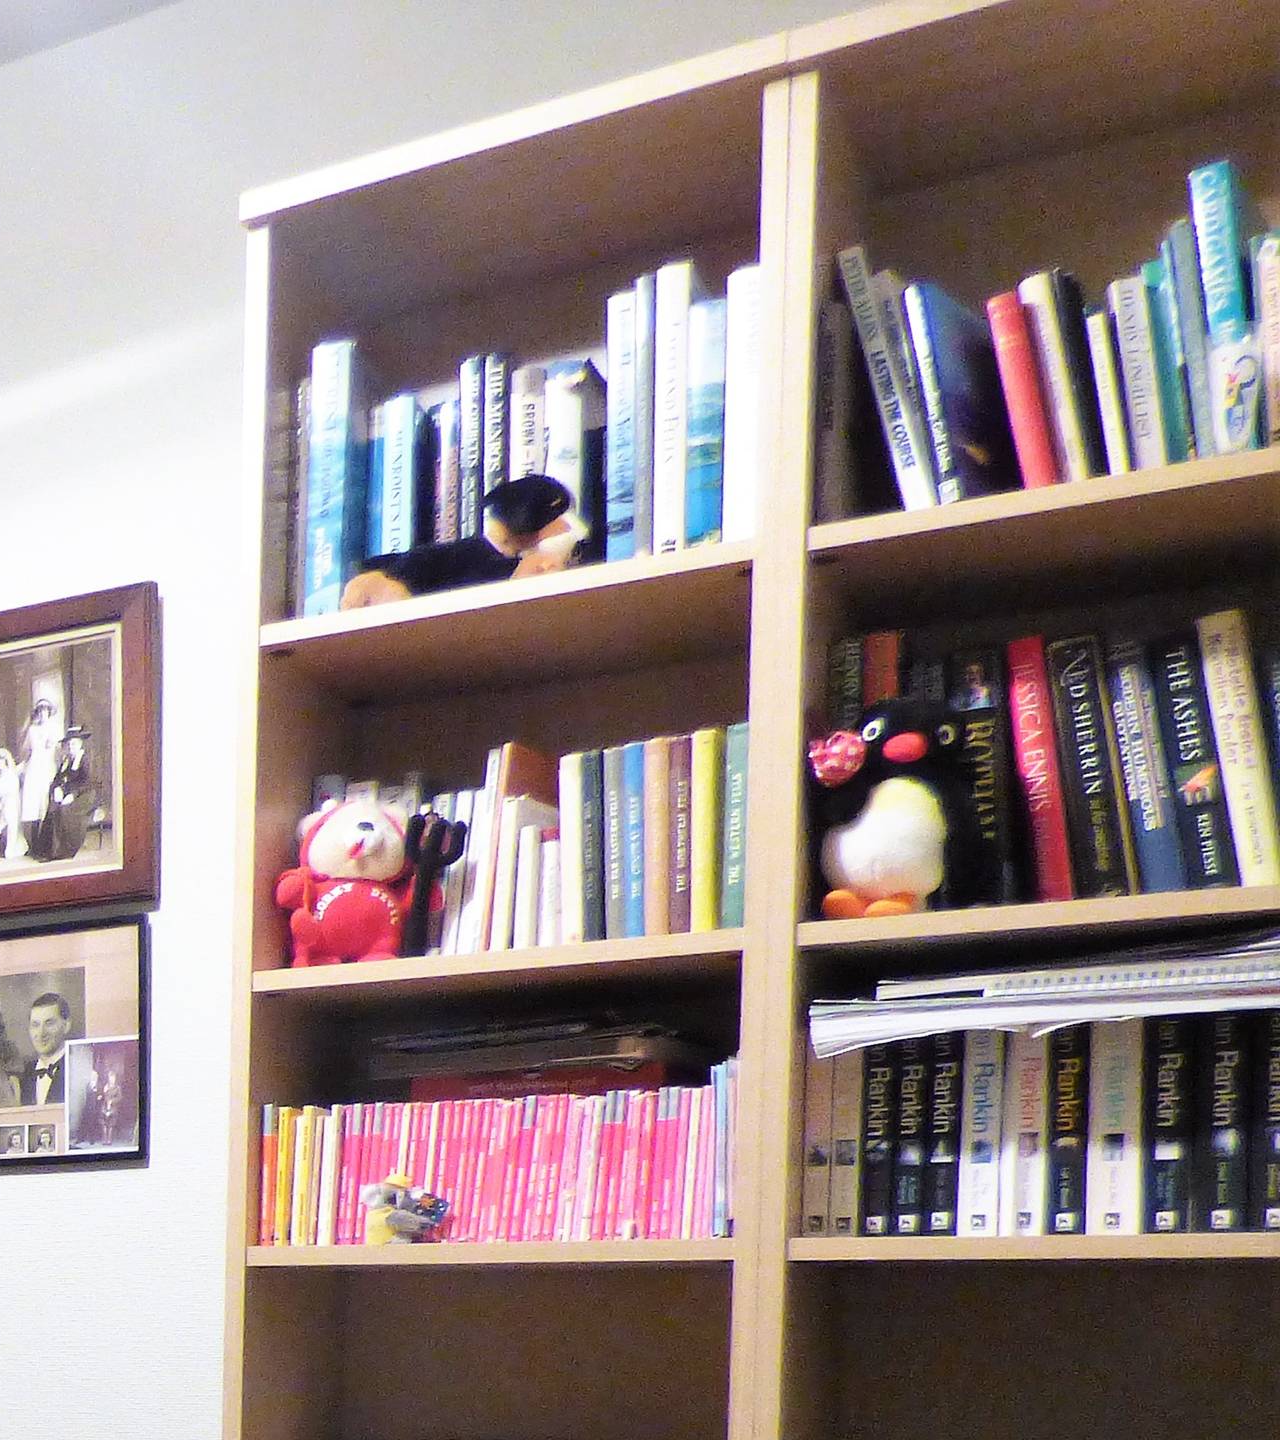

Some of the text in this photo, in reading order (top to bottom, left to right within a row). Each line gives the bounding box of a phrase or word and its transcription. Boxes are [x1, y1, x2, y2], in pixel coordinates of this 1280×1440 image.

[871, 349, 897, 401] LASTING
[1120, 284, 1139, 342] HENRY
[1134, 348, 1152, 438] LONGHURST
[489, 367, 505, 472] THE MUNROS
[521, 402, 536, 446] BROWN
[885, 399, 903, 424] THE
[893, 423, 917, 470] COURSE
[1120, 666, 1140, 734] MODERN
[1165, 647, 1201, 762] THE ASHES
[1011, 662, 1052, 812] JESSICA ENNIS
[1072, 701, 1102, 795] SHERRIN
[728, 772, 743, 885] THE WESTERN FELLS
[1195, 813, 1212, 838] KEN
[371, 886, 398, 925] DEVIL
[866, 1067, 890, 1137] Rankin
[898, 1065, 925, 1135] Rankin
[932, 1061, 958, 1134] Rankin
[972, 1062, 995, 1133] Rankin
[1019, 1057, 1042, 1128] Rankin
[1054, 1057, 1082, 1131] Rankin
[1155, 1052, 1185, 1128] Rankin
[1211, 1049, 1239, 1127] Rankin
